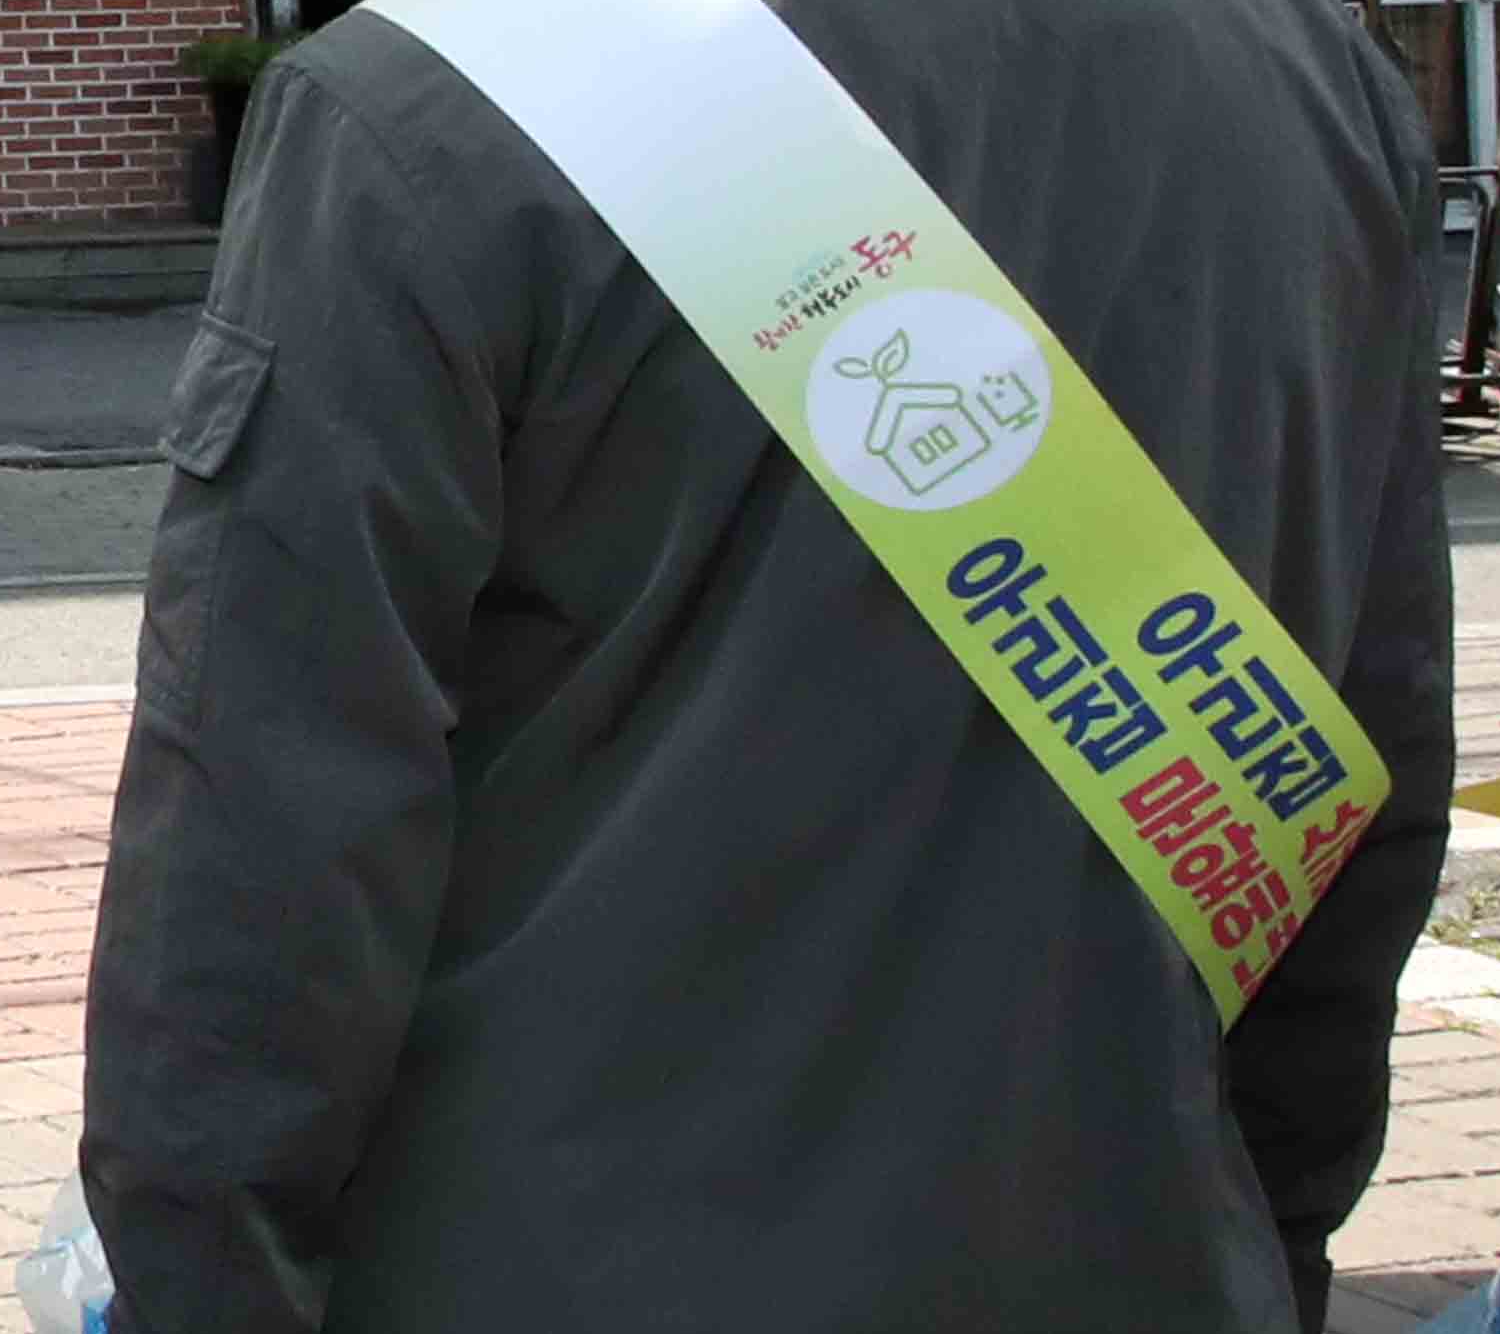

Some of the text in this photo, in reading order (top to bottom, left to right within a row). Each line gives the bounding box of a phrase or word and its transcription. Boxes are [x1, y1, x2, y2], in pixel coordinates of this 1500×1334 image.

[848, 227, 918, 280] 동구
[945, 535, 1169, 776] 우리집
[1136, 590, 1350, 823] 우리집
